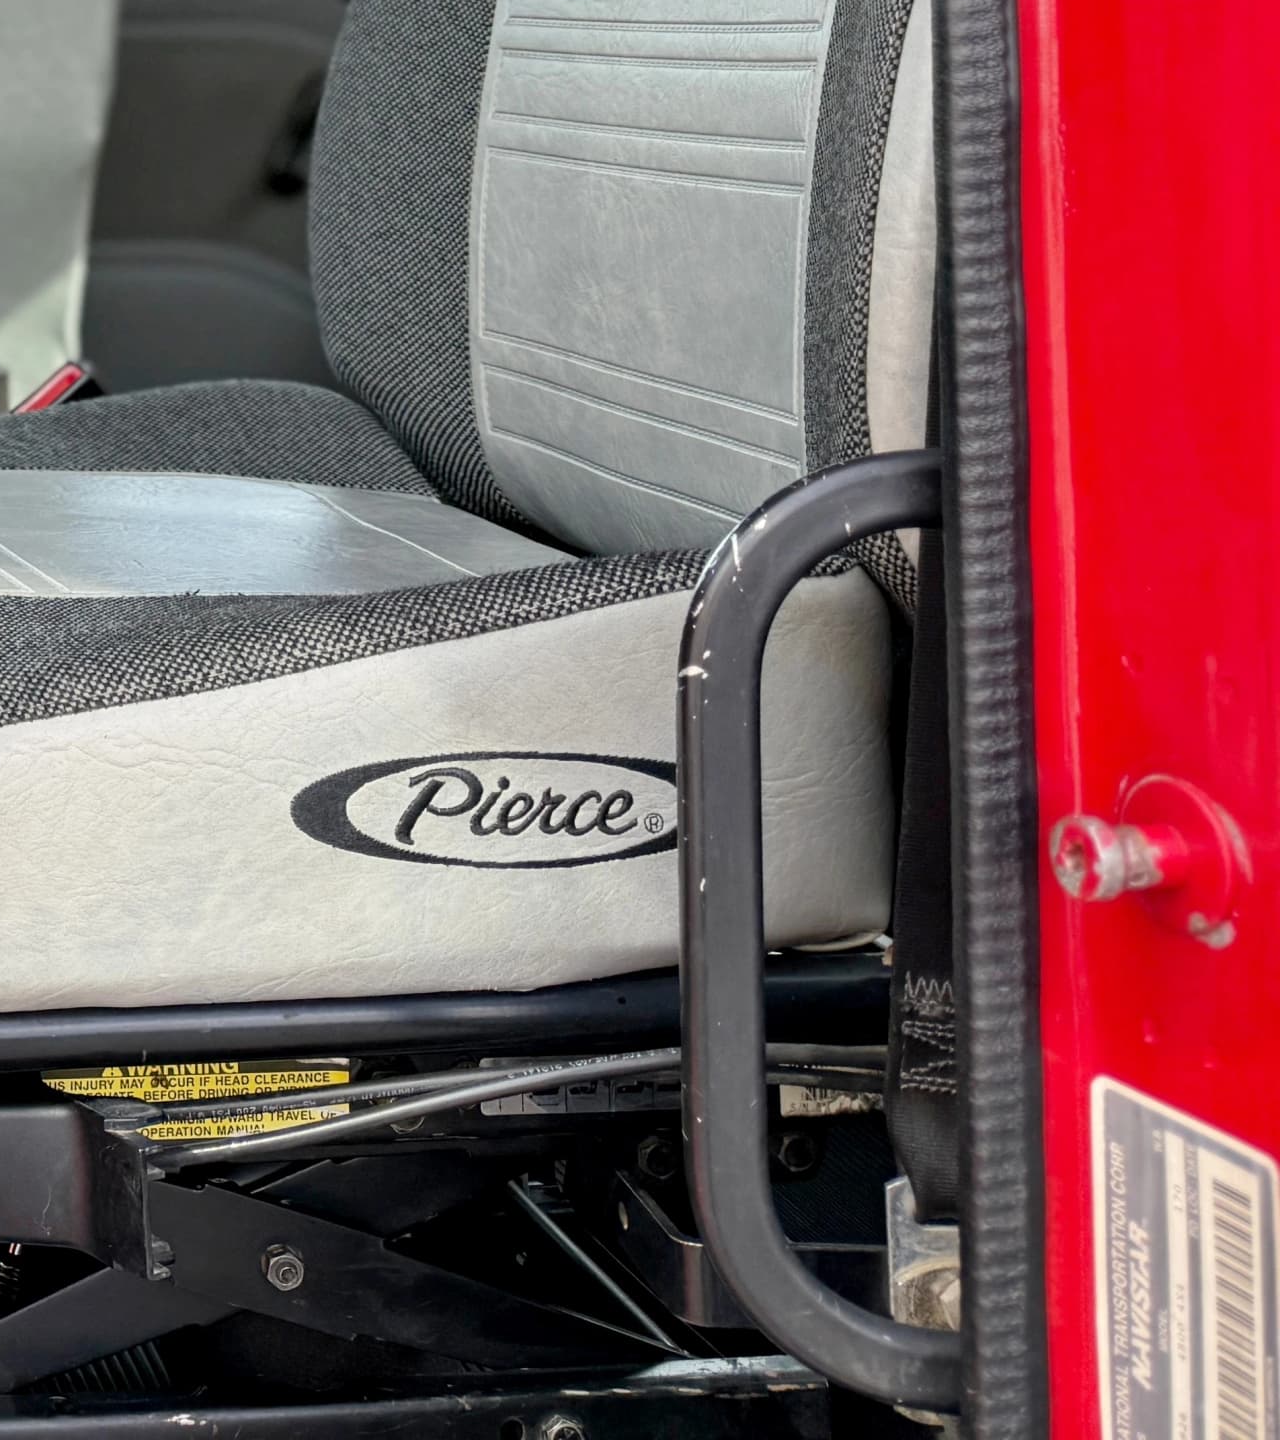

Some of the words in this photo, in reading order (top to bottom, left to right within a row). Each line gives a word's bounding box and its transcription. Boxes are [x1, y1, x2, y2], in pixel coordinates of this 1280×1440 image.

[395, 767, 639, 845] Pierce
[70, 1080, 114, 1091] INJURY
[120, 1078, 144, 1090] MAY
[151, 1077, 194, 1089] OCCUR
[199, 1076, 211, 1087] IF
[216, 1074, 249, 1086] HEAD
[255, 1072, 330, 1084] CLEARANCE
[144, 1090, 194, 1101] BEFORE
[199, 1087, 249, 1099] DRIVING
[271, 1109, 316, 1121] TRAVEL
[141, 1126, 211, 1138] OPERATION
[1110, 1196, 1128, 1358] TRANSPORTATION
[1129, 1219, 1152, 1391] NAVISTAR
